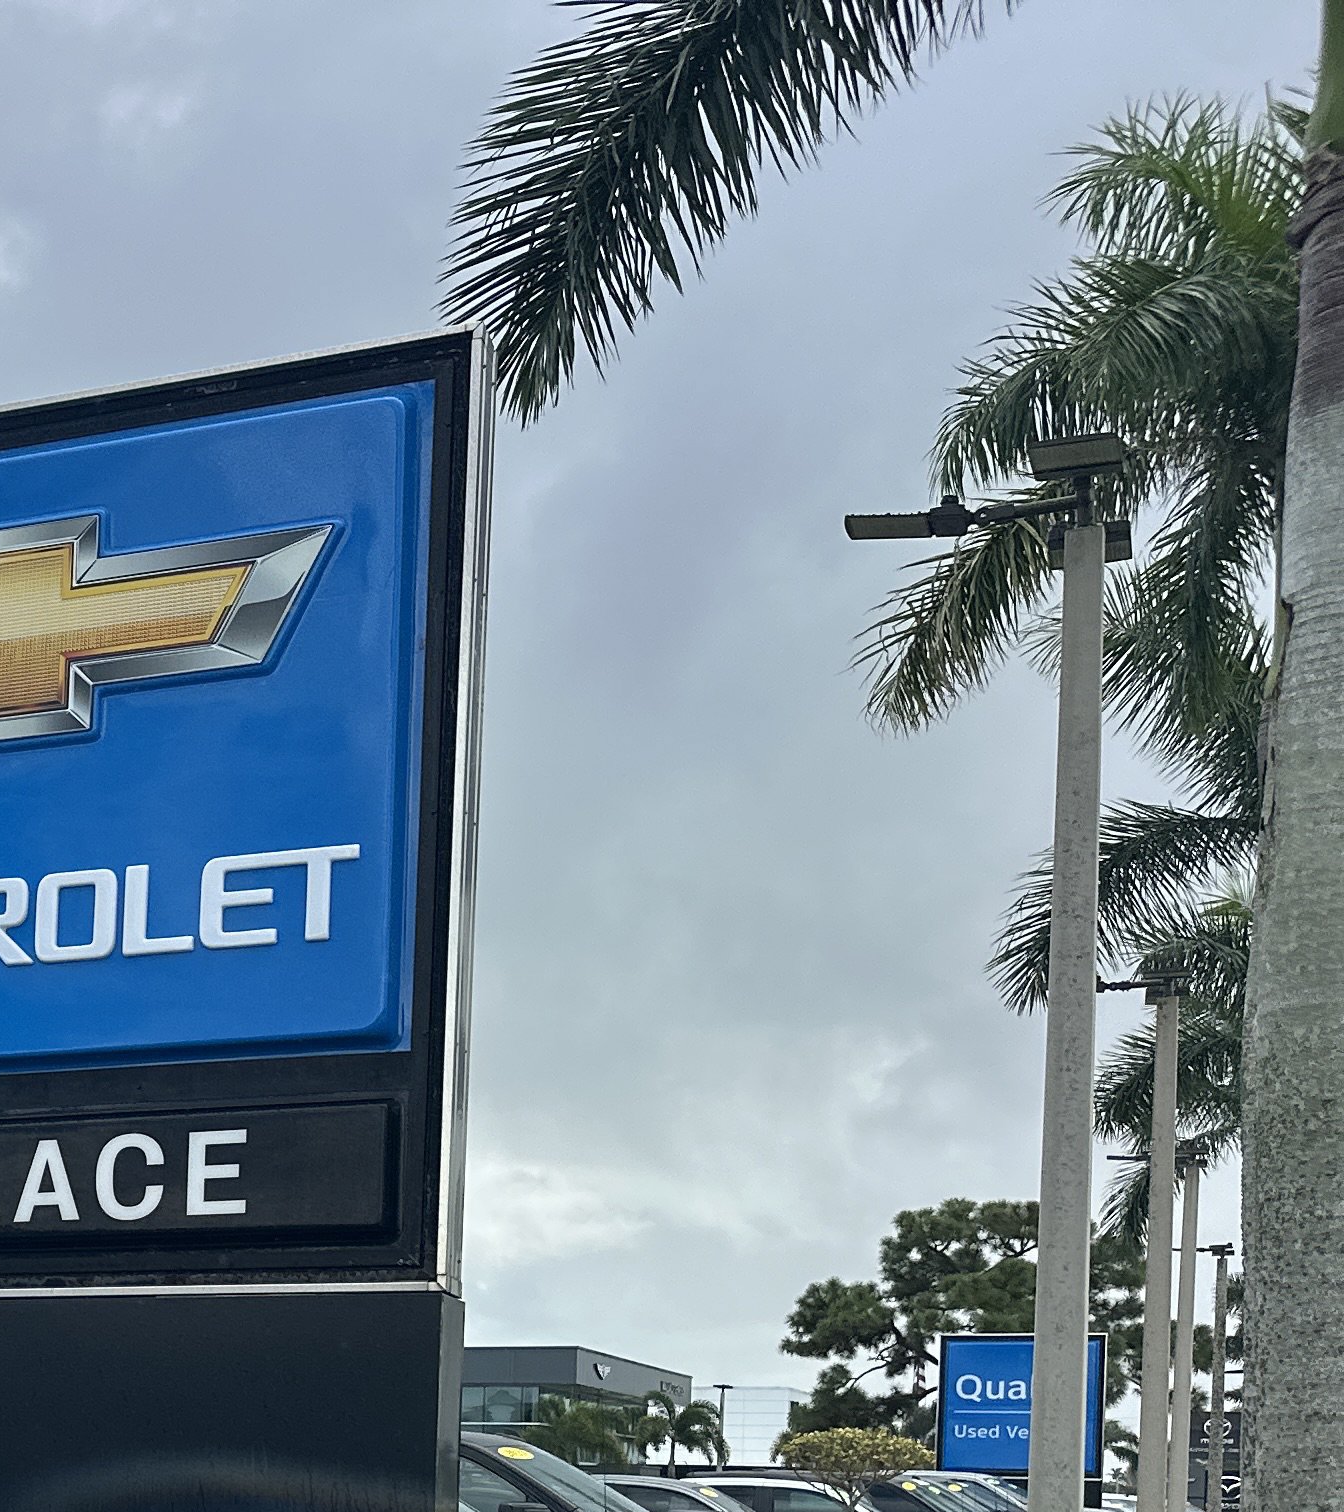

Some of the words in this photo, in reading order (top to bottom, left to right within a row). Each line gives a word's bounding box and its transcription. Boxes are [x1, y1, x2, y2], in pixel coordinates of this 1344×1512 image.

[955, 1374, 1033, 1402] Qua
[954, 1424, 1000, 1439] Used
[1006, 1425, 1029, 1439] Ve
